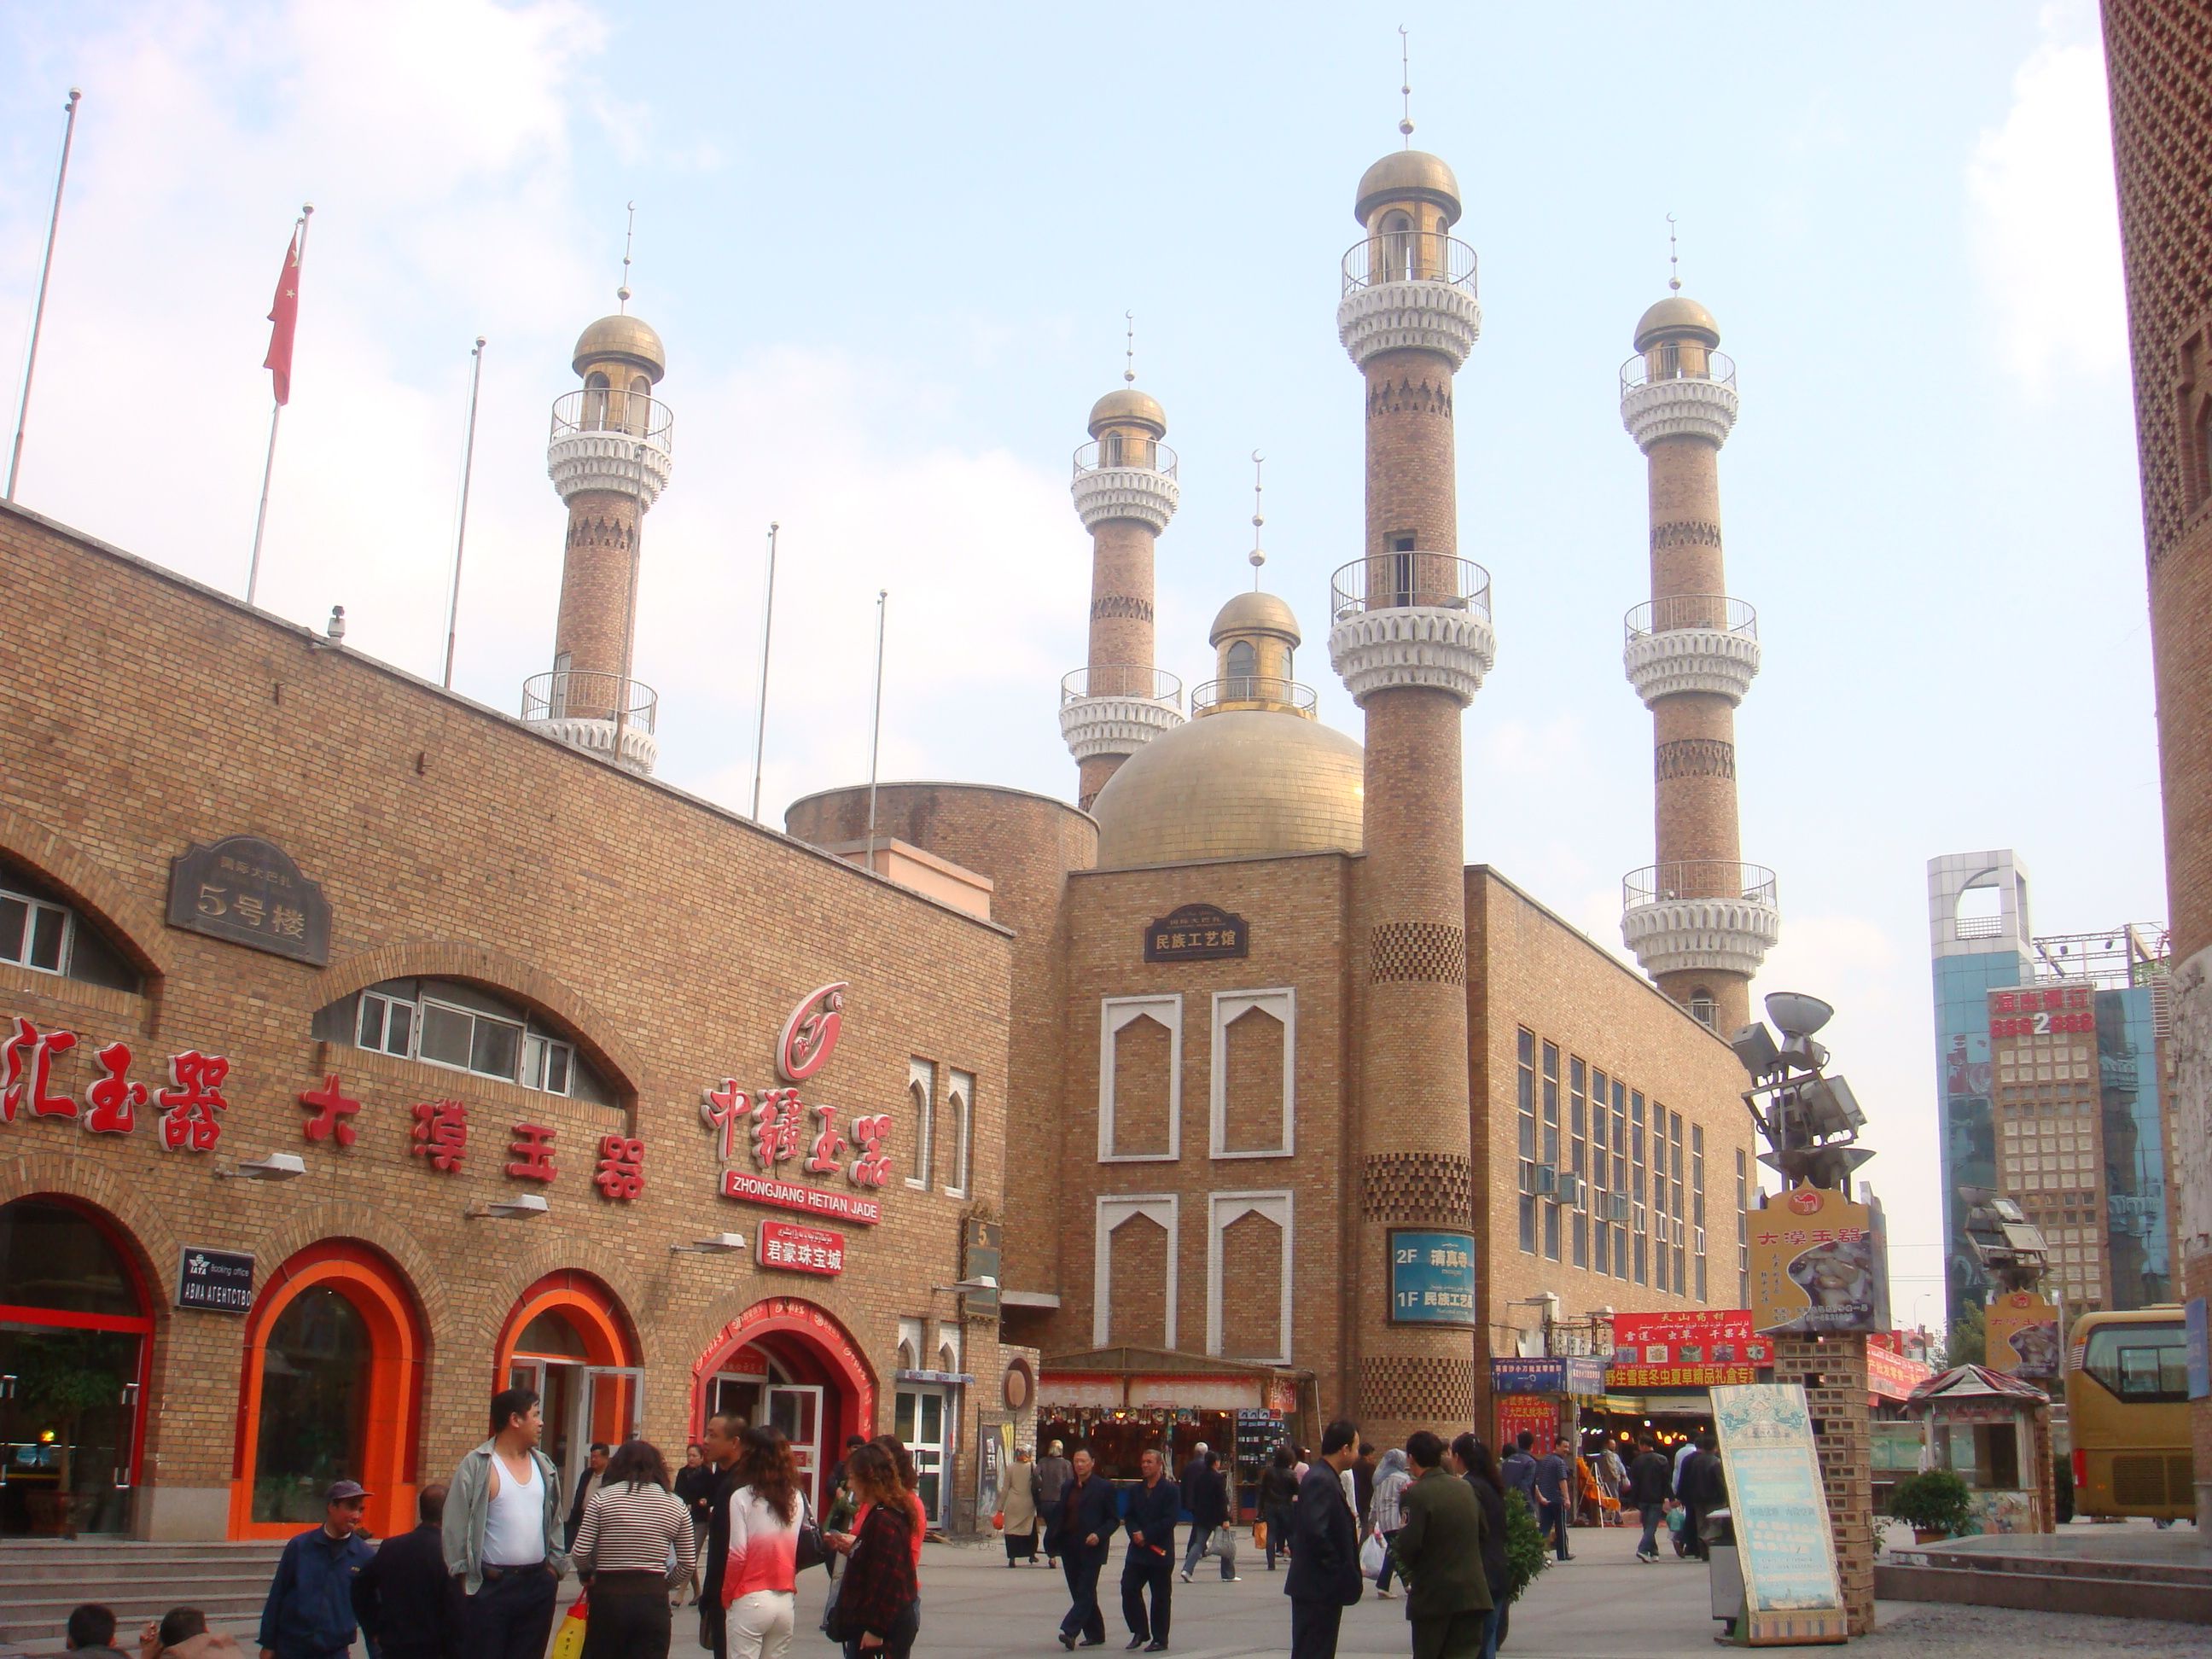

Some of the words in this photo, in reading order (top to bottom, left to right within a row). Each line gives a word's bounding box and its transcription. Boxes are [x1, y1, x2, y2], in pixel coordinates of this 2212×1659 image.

[197, 882, 306, 940] 5号楼
[1155, 929, 1237, 950] 民族工艺馆
[298, 1073, 646, 1200] 大漠玉器
[732, 1176, 805, 1203] ZHONGJIANG
[807, 1191, 847, 1213] HETIAN
[850, 1201, 877, 1219] JADE
[1756, 1227, 1863, 1246] 大漠玉器
[766, 1240, 842, 1271] 君豪珠宝城
[1396, 1249, 1417, 1264] 2F
[190, 1266, 207, 1275] IATA
[211, 1264, 232, 1276] Booking
[233, 1267, 250, 1277] office
[184, 1283, 205, 1301] АВИА
[207, 1285, 252, 1307] АГЕНТСТВО
[1398, 1291, 1418, 1307] 1F
